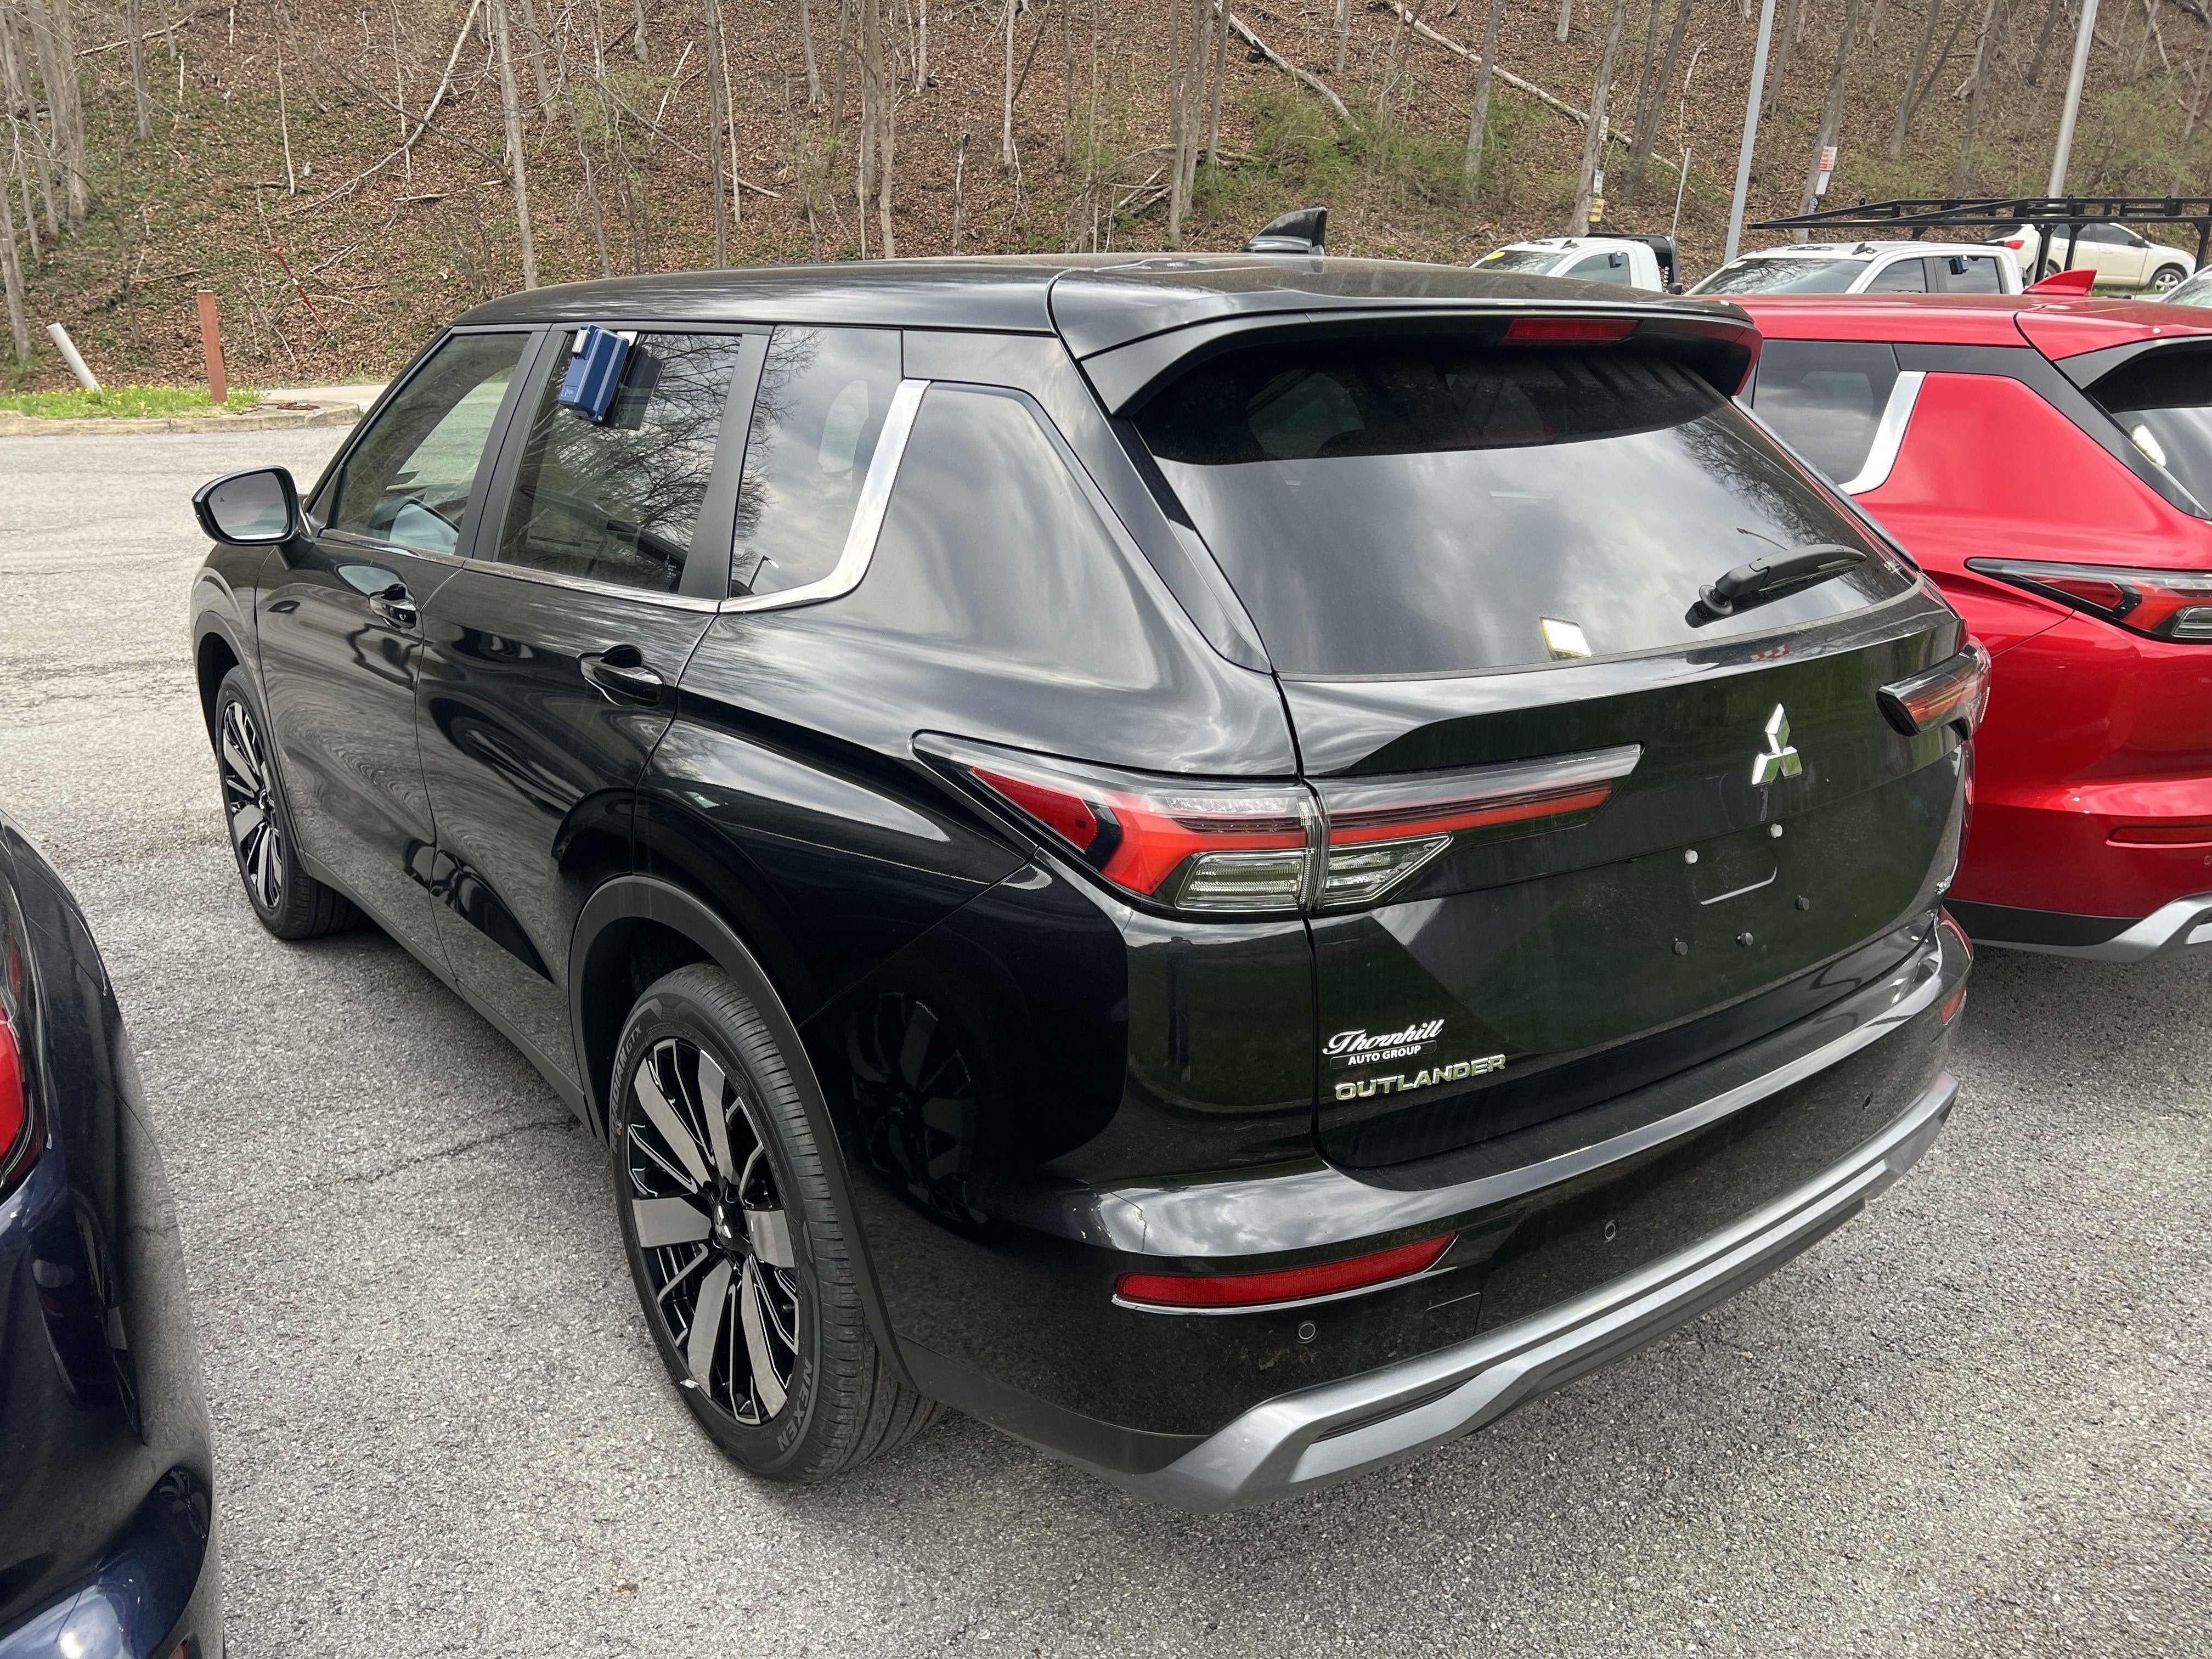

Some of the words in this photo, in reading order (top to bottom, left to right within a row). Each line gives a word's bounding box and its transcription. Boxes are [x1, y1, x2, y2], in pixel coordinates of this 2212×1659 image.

[626, 1024, 642, 1054] GTX
[1322, 1019, 1445, 1054] Thornhill
[1347, 1052, 1380, 1065] AUTO
[1382, 1045, 1421, 1060] GROUP
[1334, 1054, 1506, 1101] OUTLANDER
[777, 1357, 812, 1452] NEXEN
